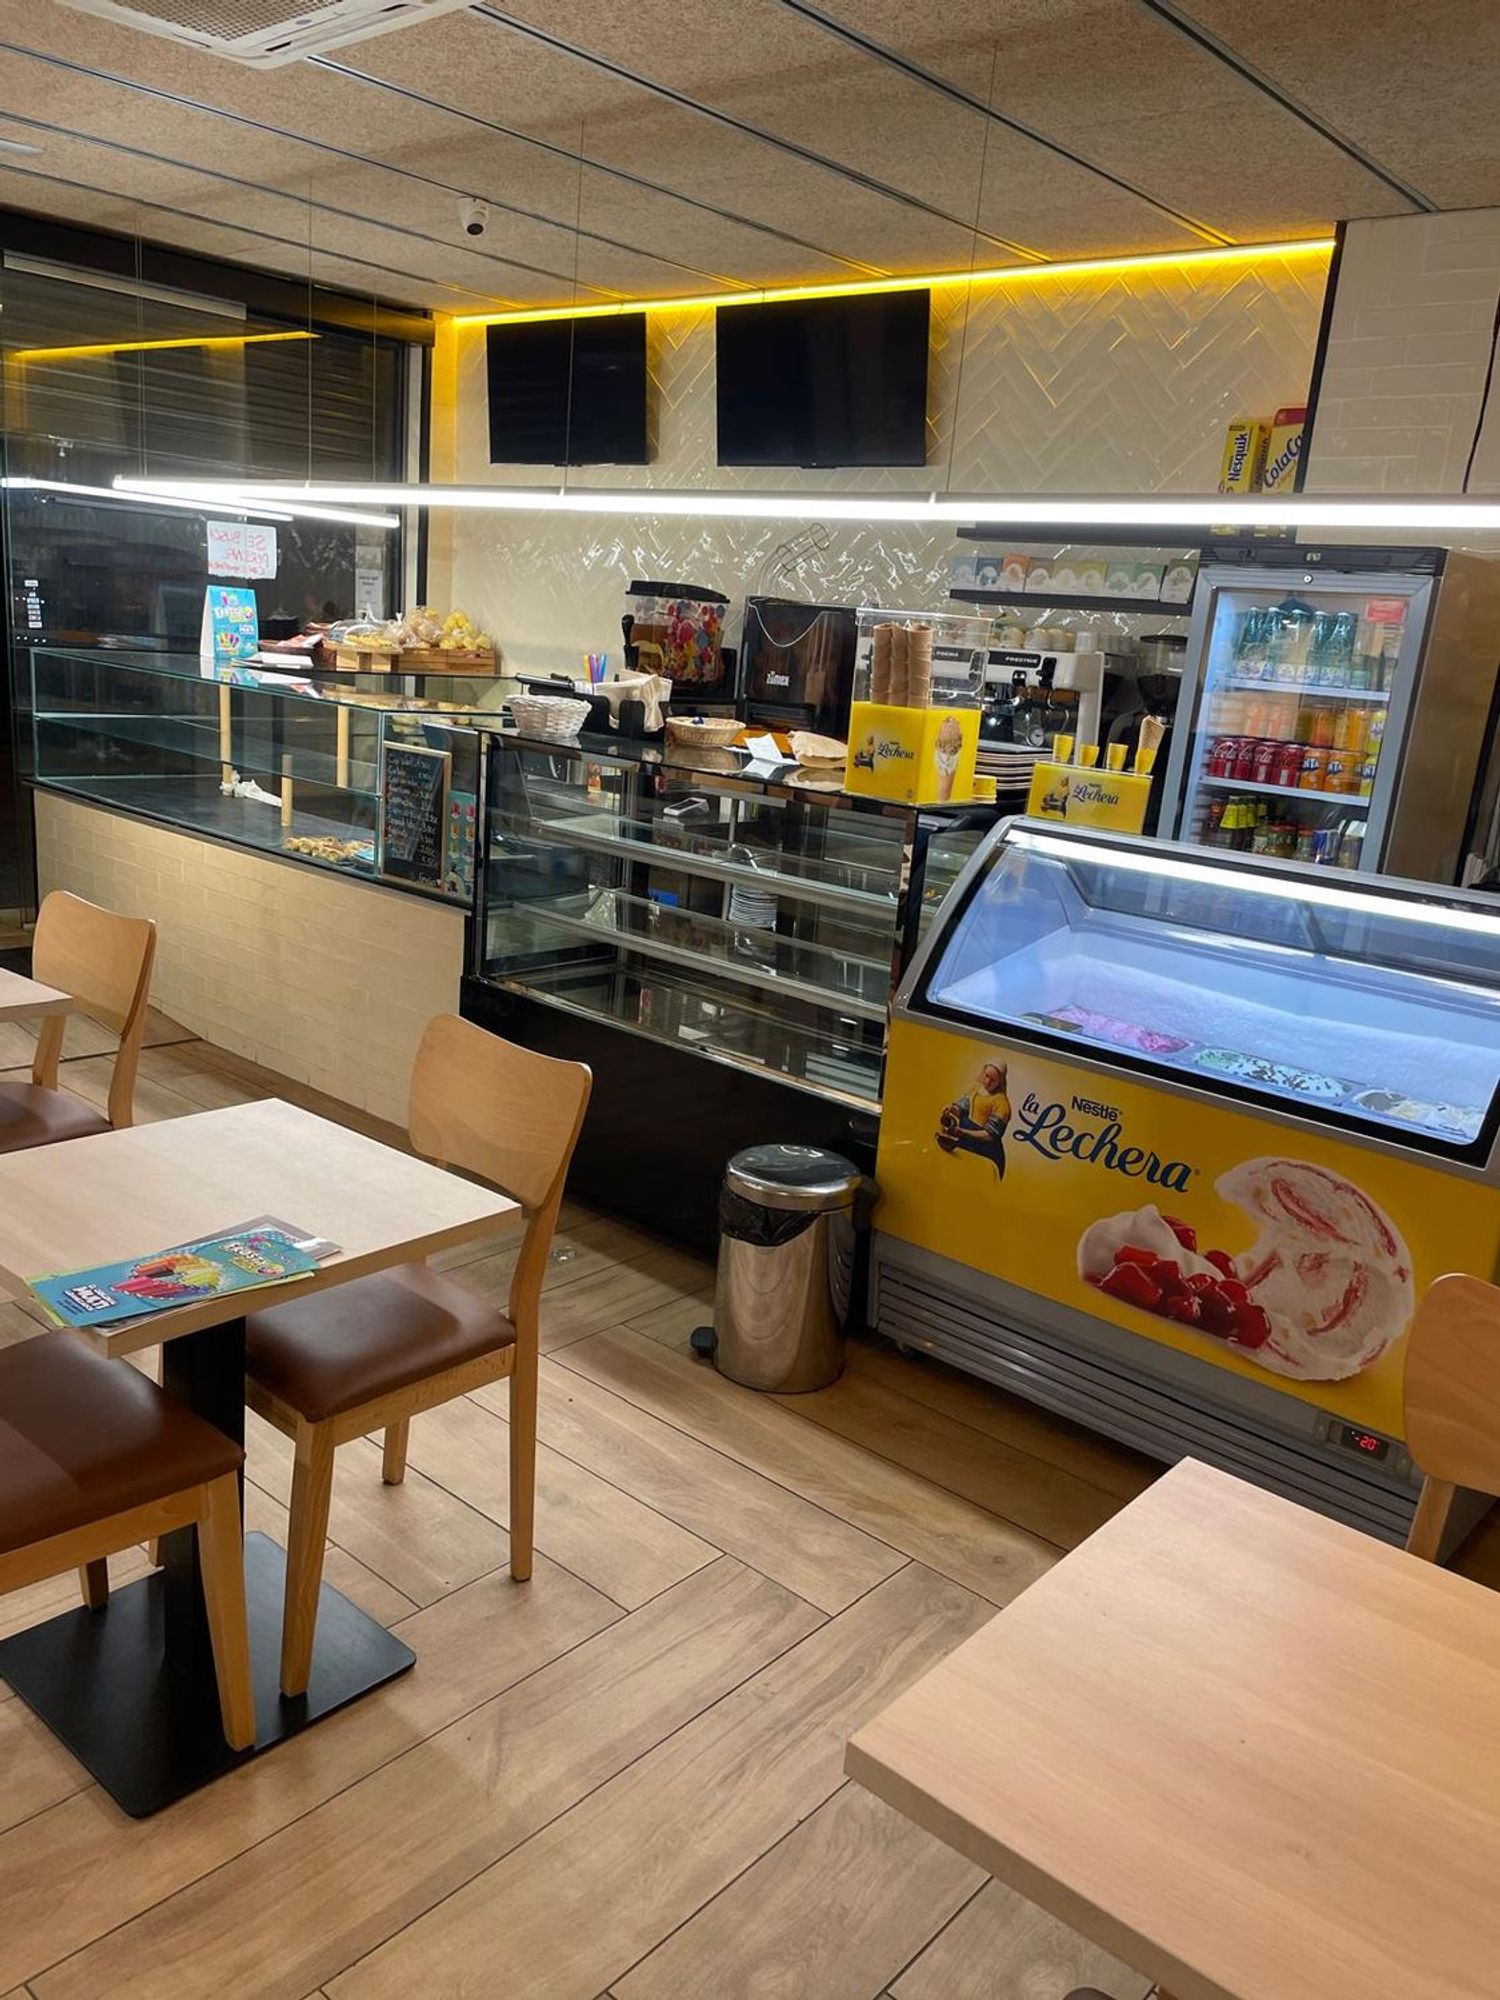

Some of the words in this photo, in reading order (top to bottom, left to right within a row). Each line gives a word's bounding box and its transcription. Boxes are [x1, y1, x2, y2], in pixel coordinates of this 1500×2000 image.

[1227, 433, 1248, 481] Nesquik
[1022, 1093, 1040, 1115] la
[1013, 1103, 1193, 1193] Lechera
